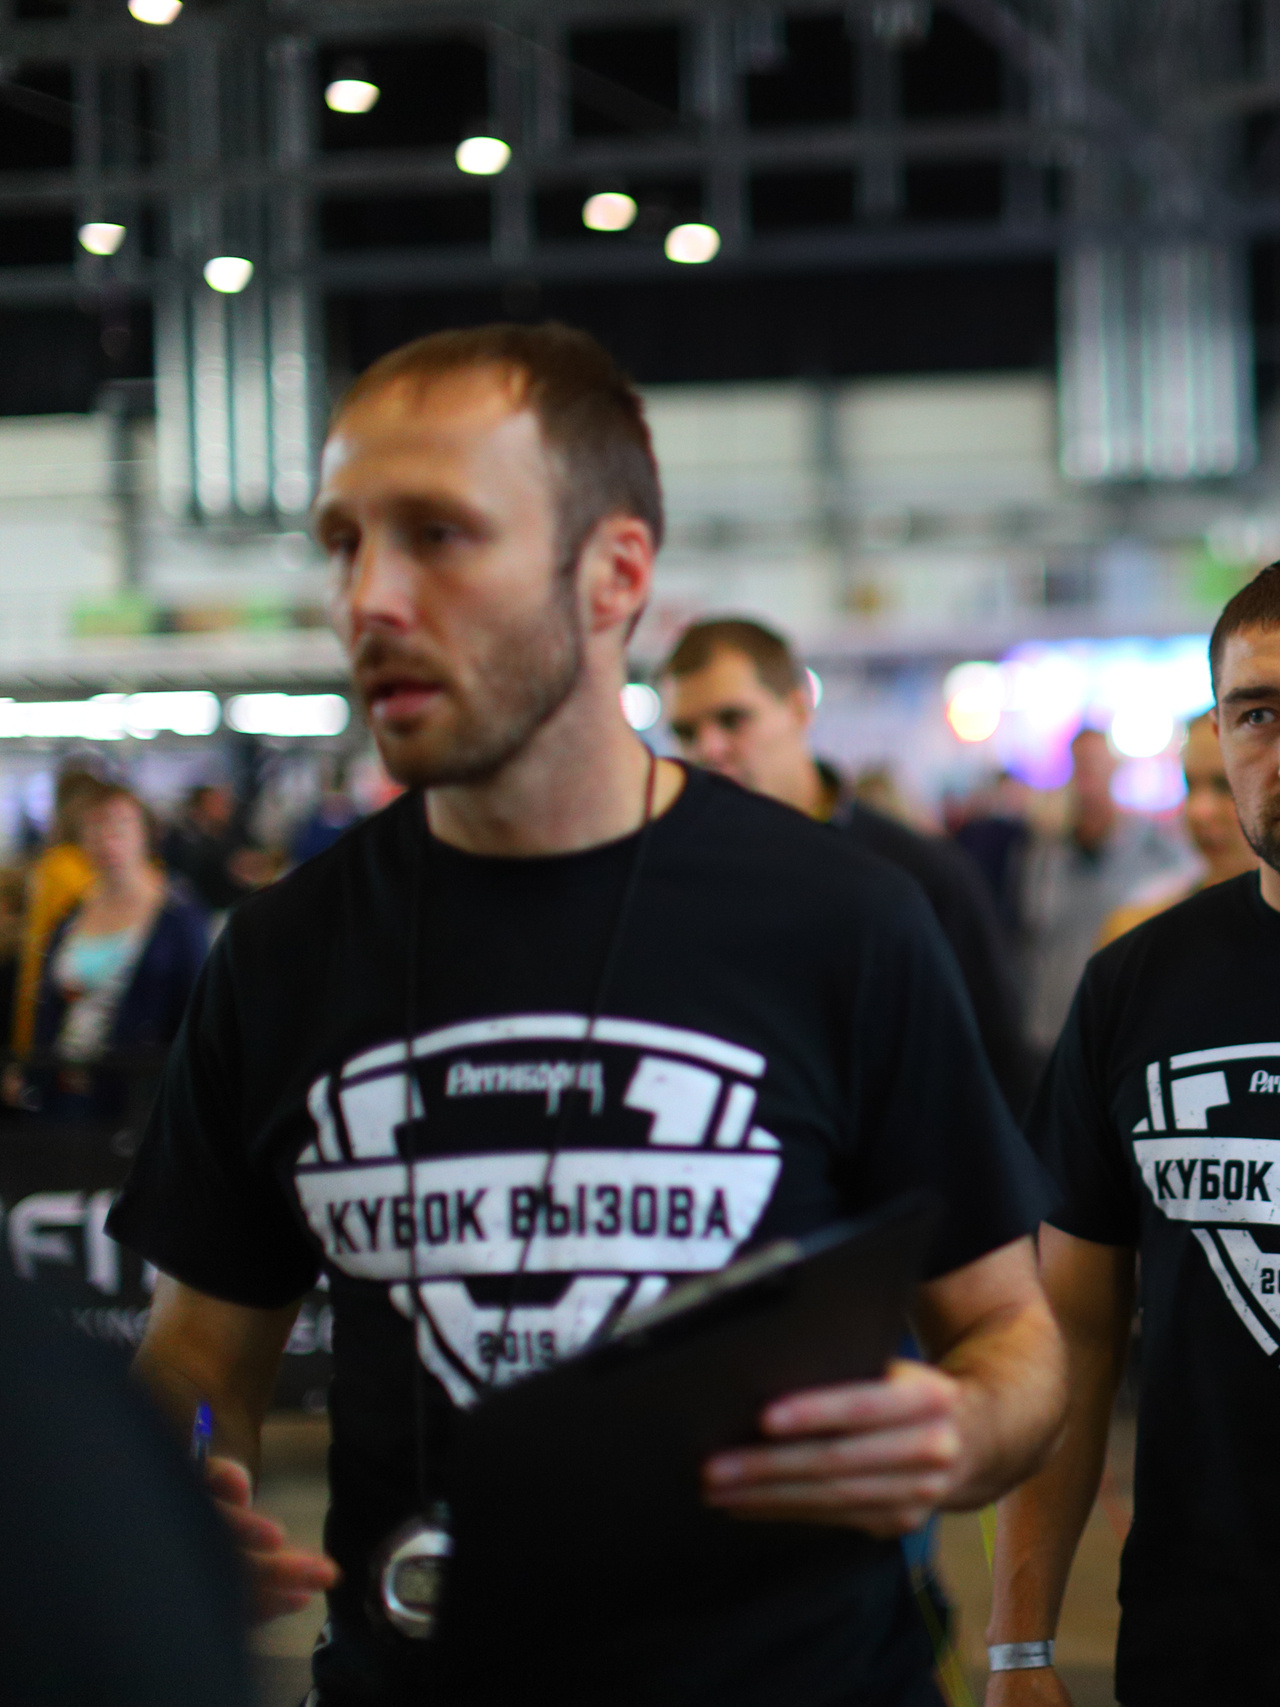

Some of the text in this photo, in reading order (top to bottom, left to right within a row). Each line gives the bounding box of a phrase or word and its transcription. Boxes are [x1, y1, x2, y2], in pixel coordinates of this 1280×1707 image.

[1153, 1158, 1274, 1203] КУБОК
[328, 1183, 732, 1255] КУБОК ВЫЗОВА
